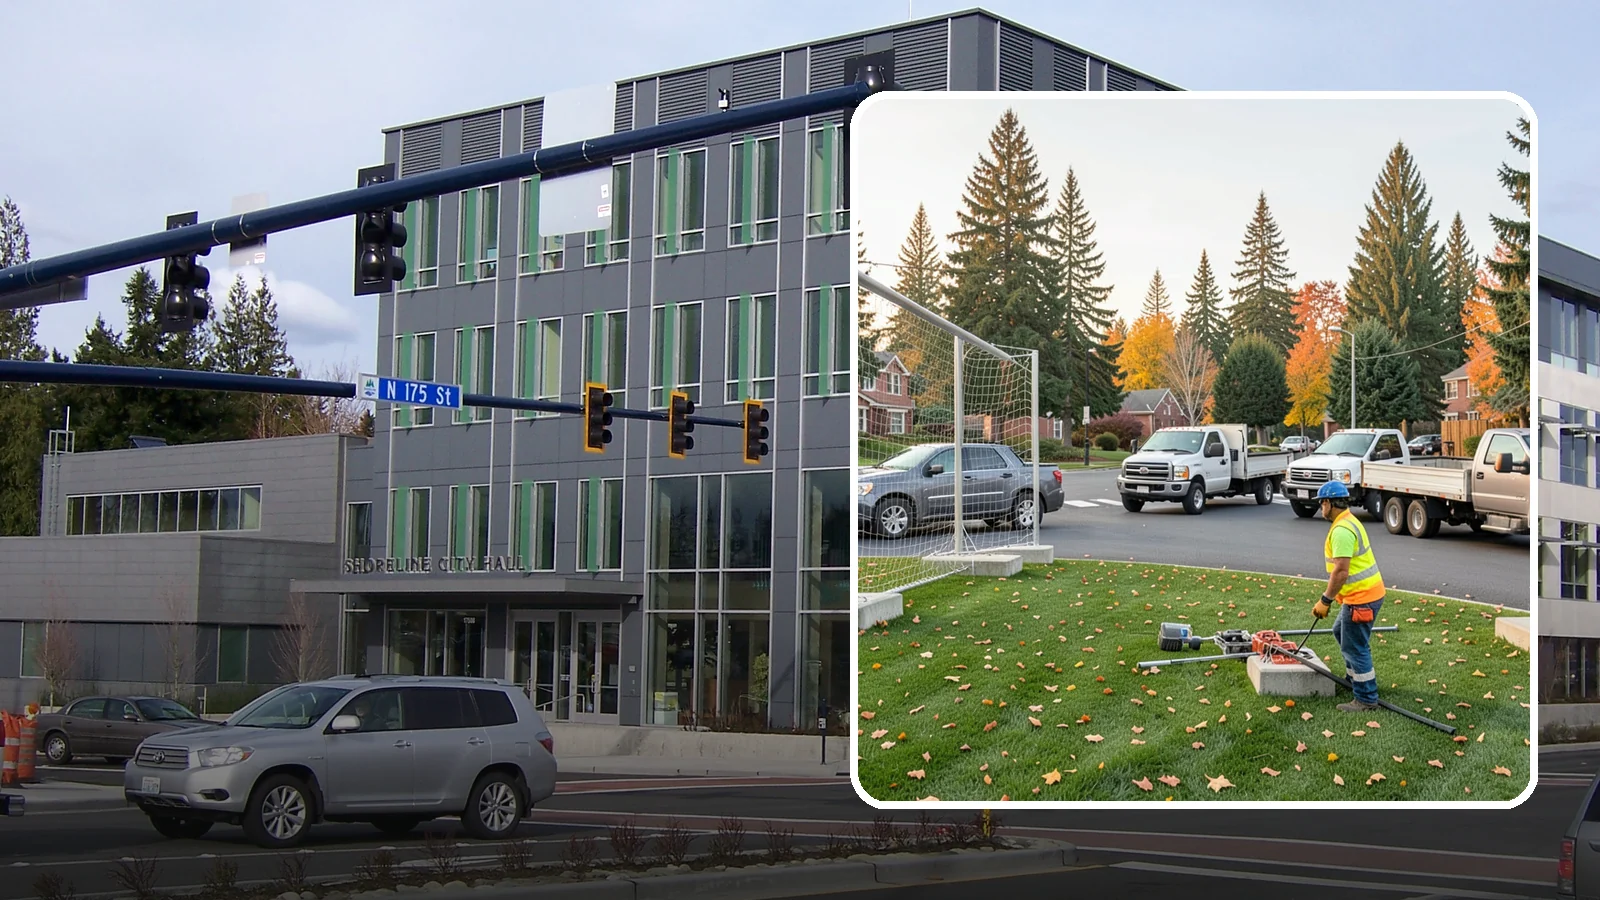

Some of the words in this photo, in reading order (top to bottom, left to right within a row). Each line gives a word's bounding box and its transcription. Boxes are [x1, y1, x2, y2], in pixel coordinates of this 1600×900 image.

[387, 380, 396, 400] N
[405, 383, 427, 403] 175
[436, 386, 451, 406] St
[344, 557, 432, 574] SHORELINE
[438, 556, 476, 572] CITY
[484, 555, 525, 571] HALL
